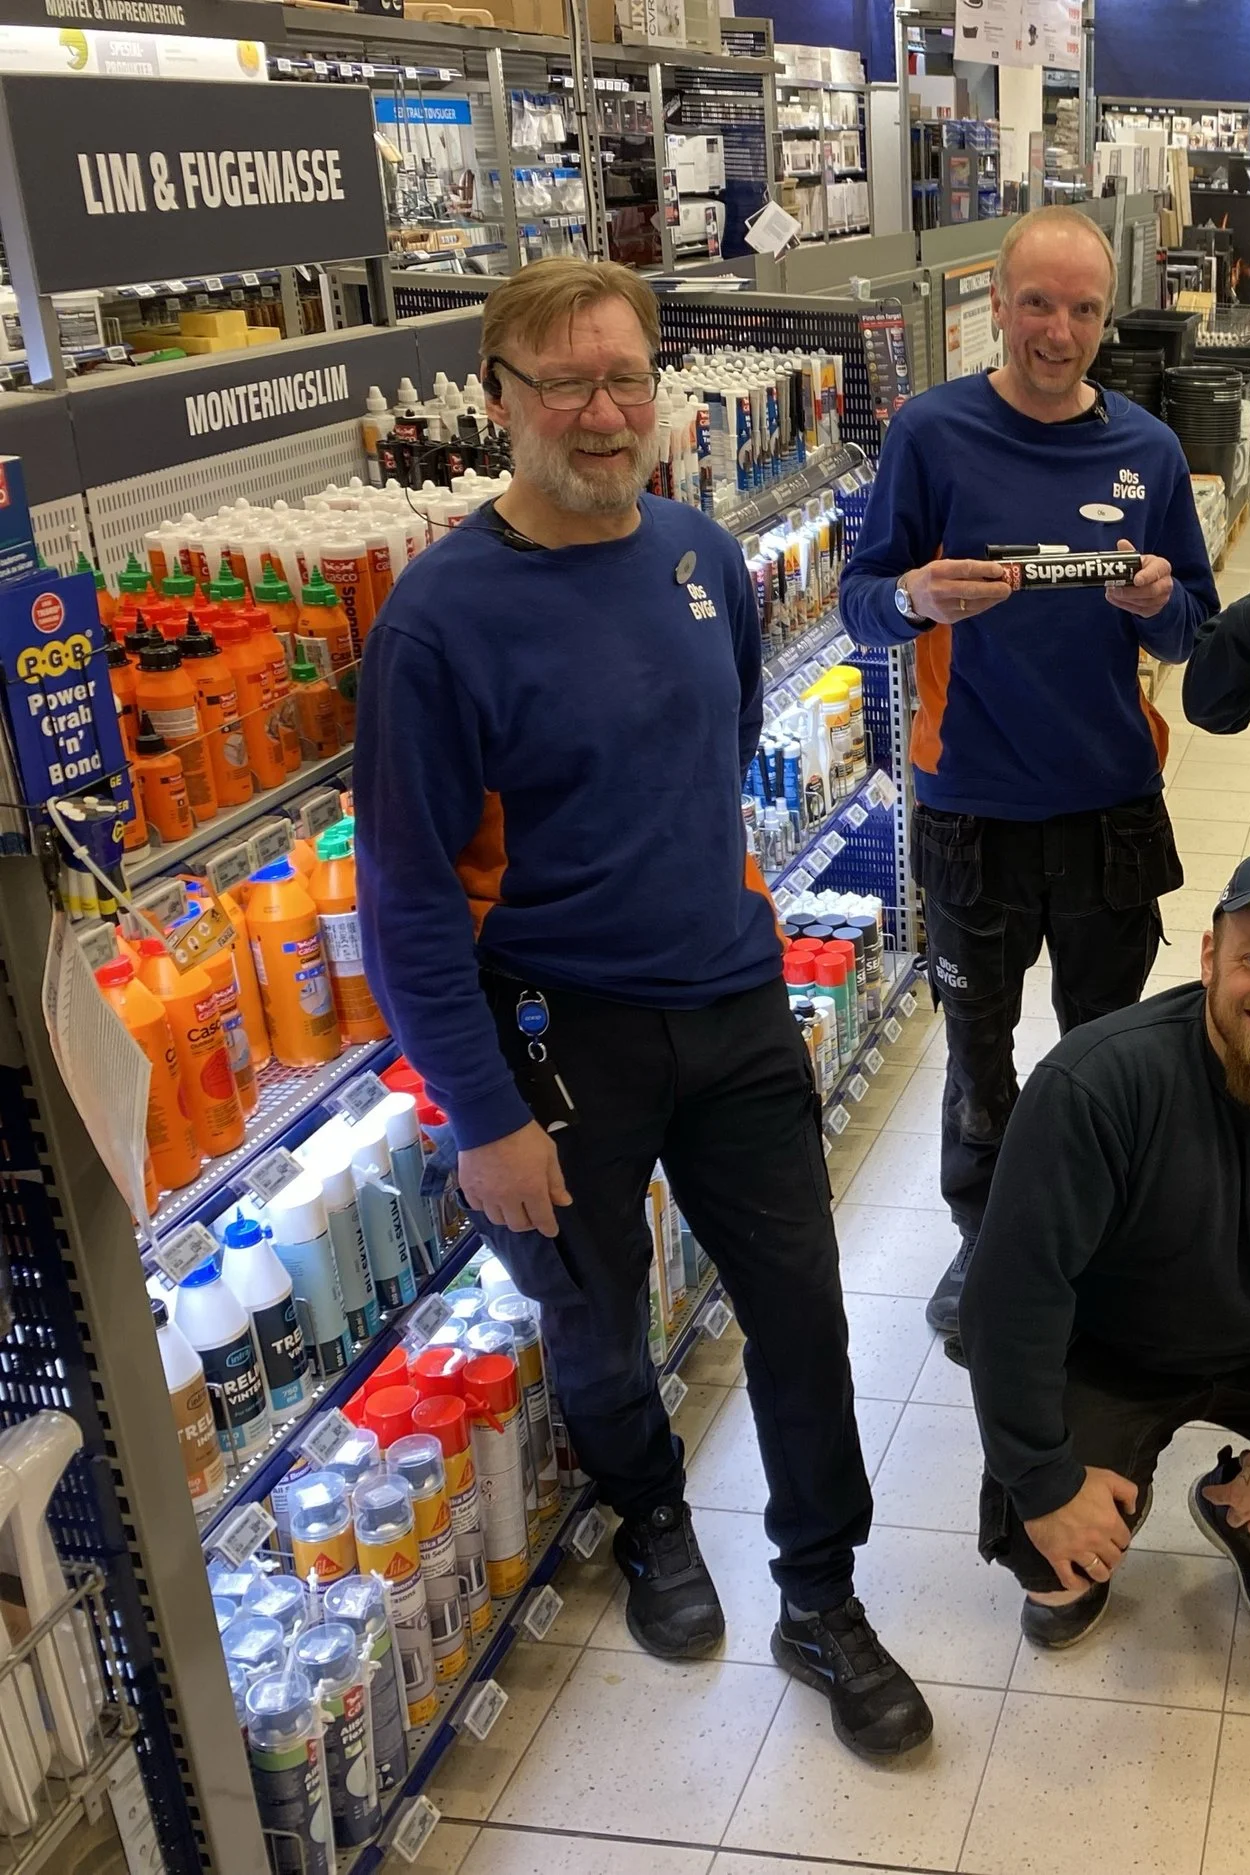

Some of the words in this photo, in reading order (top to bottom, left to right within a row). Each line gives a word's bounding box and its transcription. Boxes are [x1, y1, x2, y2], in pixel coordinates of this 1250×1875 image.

[94, 1, 104, 19] &
[105, 1, 186, 26] IMPREGNERING
[78, 152, 147, 215] LIM
[150, 151, 180, 210] &
[180, 149, 345, 209] FUGEMASSE
[185, 364, 349, 436] MONTERINGSLIM
[1119, 469, 1139, 484] Obs
[1112, 483, 1146, 500] BYGG
[1025, 559, 1127, 583] SuperFix+
[689, 599, 717, 620] BYGG
[27, 679, 97, 716] Power
[41, 704, 93, 736] Grab
[49, 749, 101, 785] Bond
[936, 965, 968, 988] BYGG
